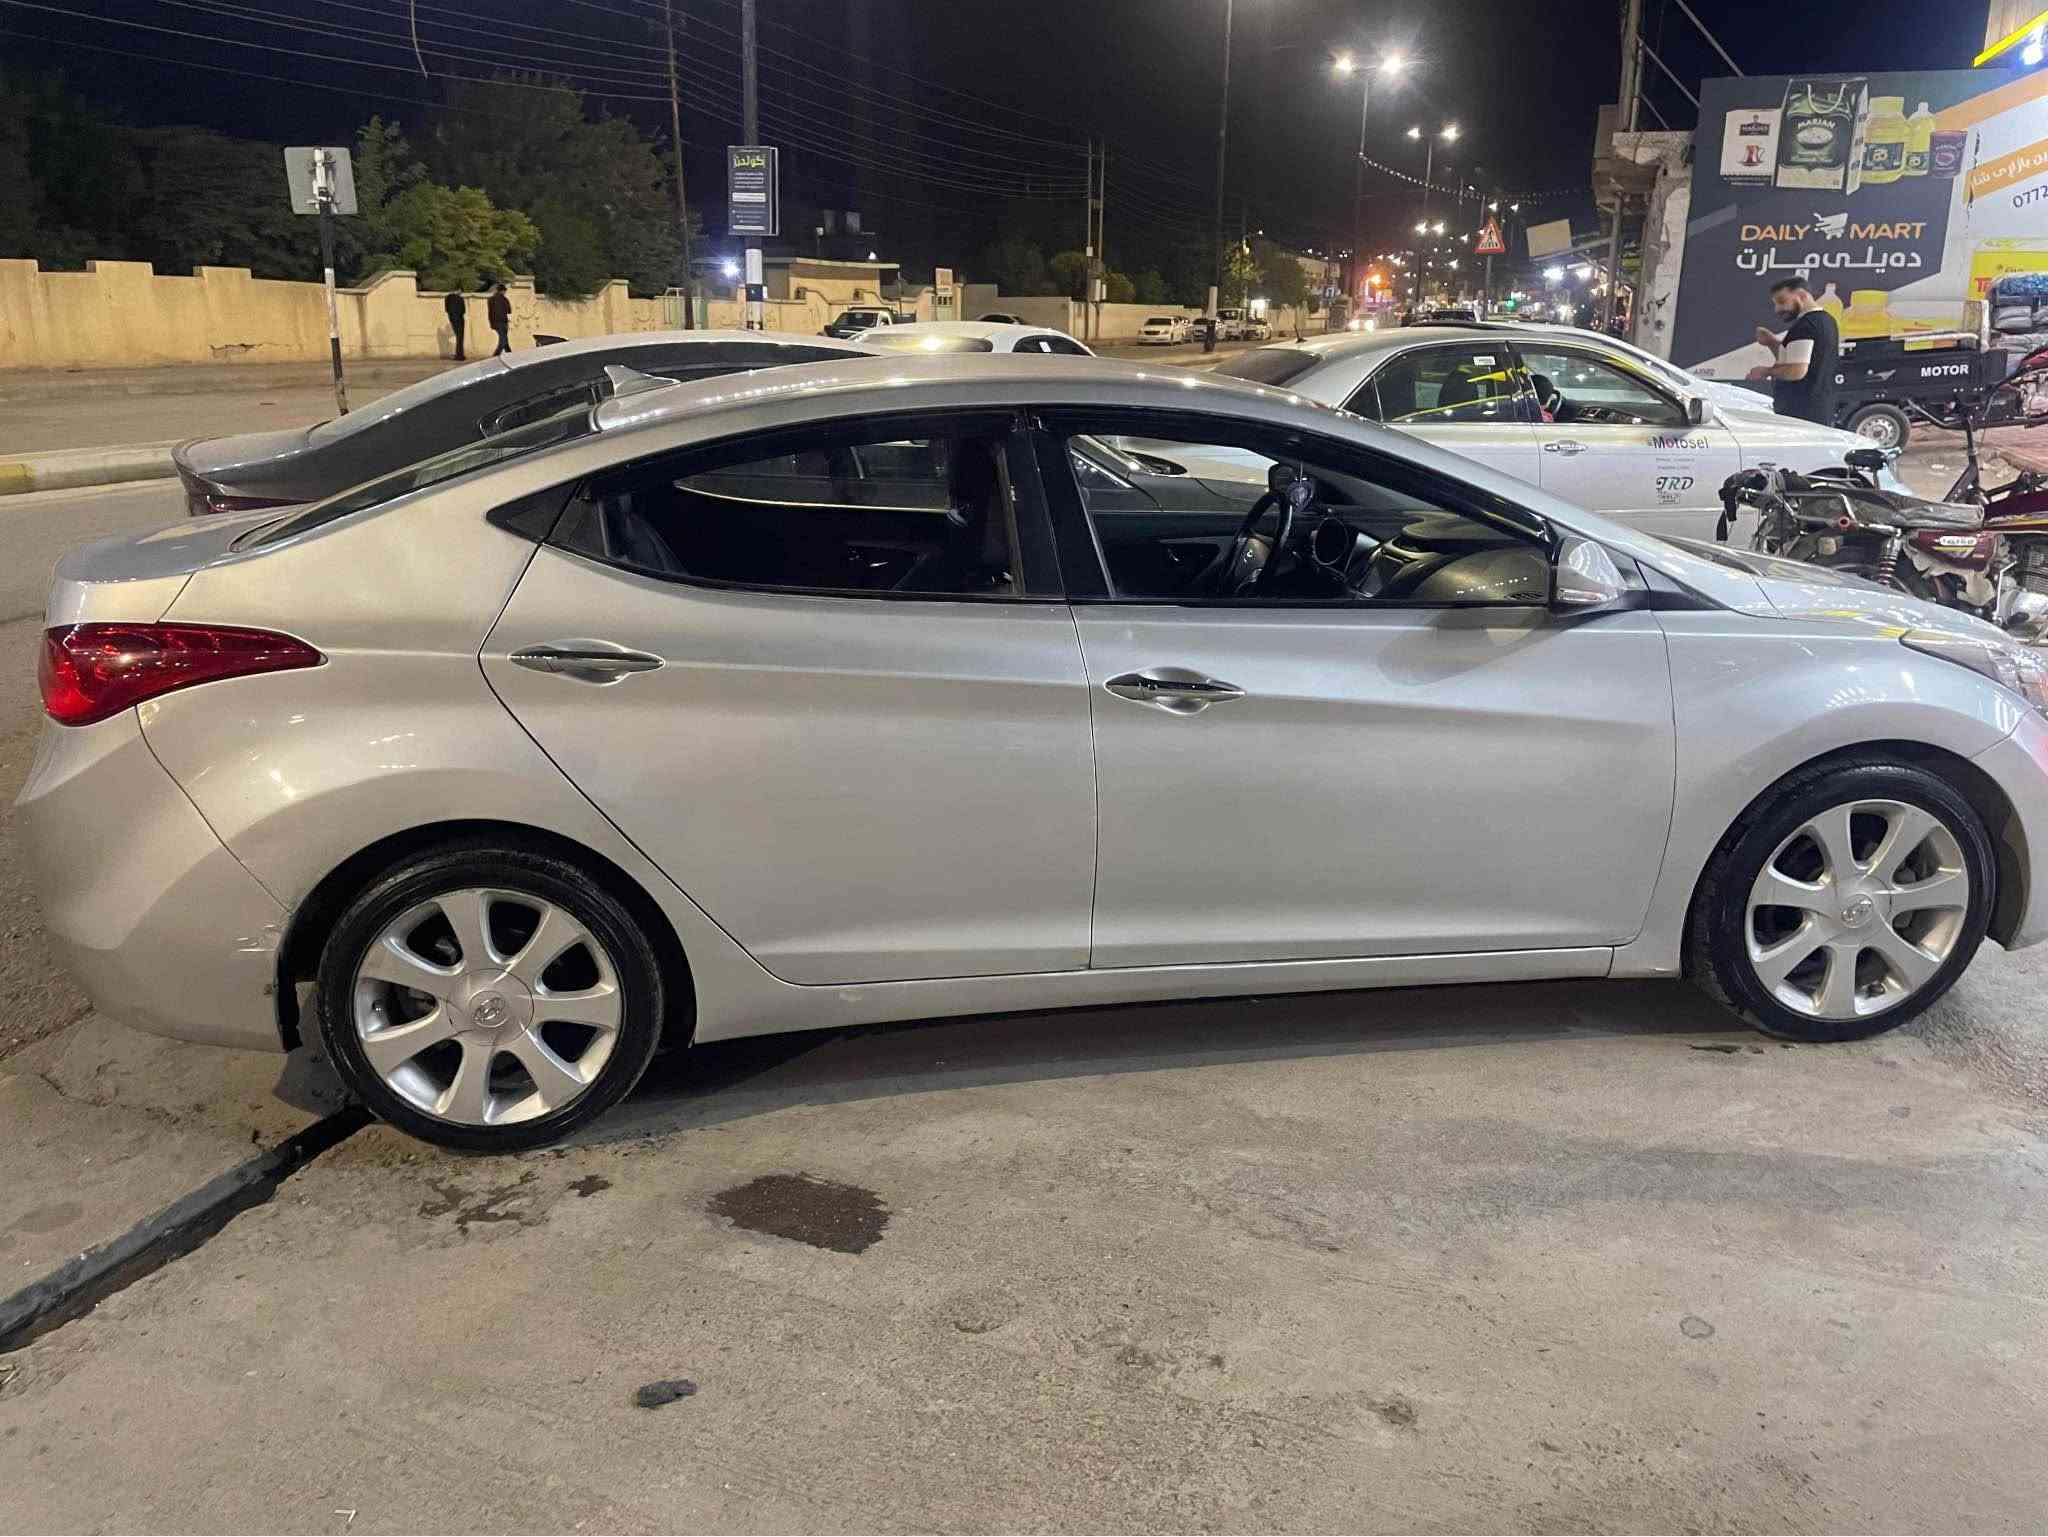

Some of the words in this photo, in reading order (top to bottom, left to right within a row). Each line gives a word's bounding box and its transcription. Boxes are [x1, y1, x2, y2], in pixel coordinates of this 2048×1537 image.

[1741, 225, 1810, 241] DAILY
[1850, 222, 1926, 239] MART
[1736, 248, 1820, 276] مارت
[1920, 364, 1969, 377] MOTOR
[1656, 476, 1694, 490] TRD
